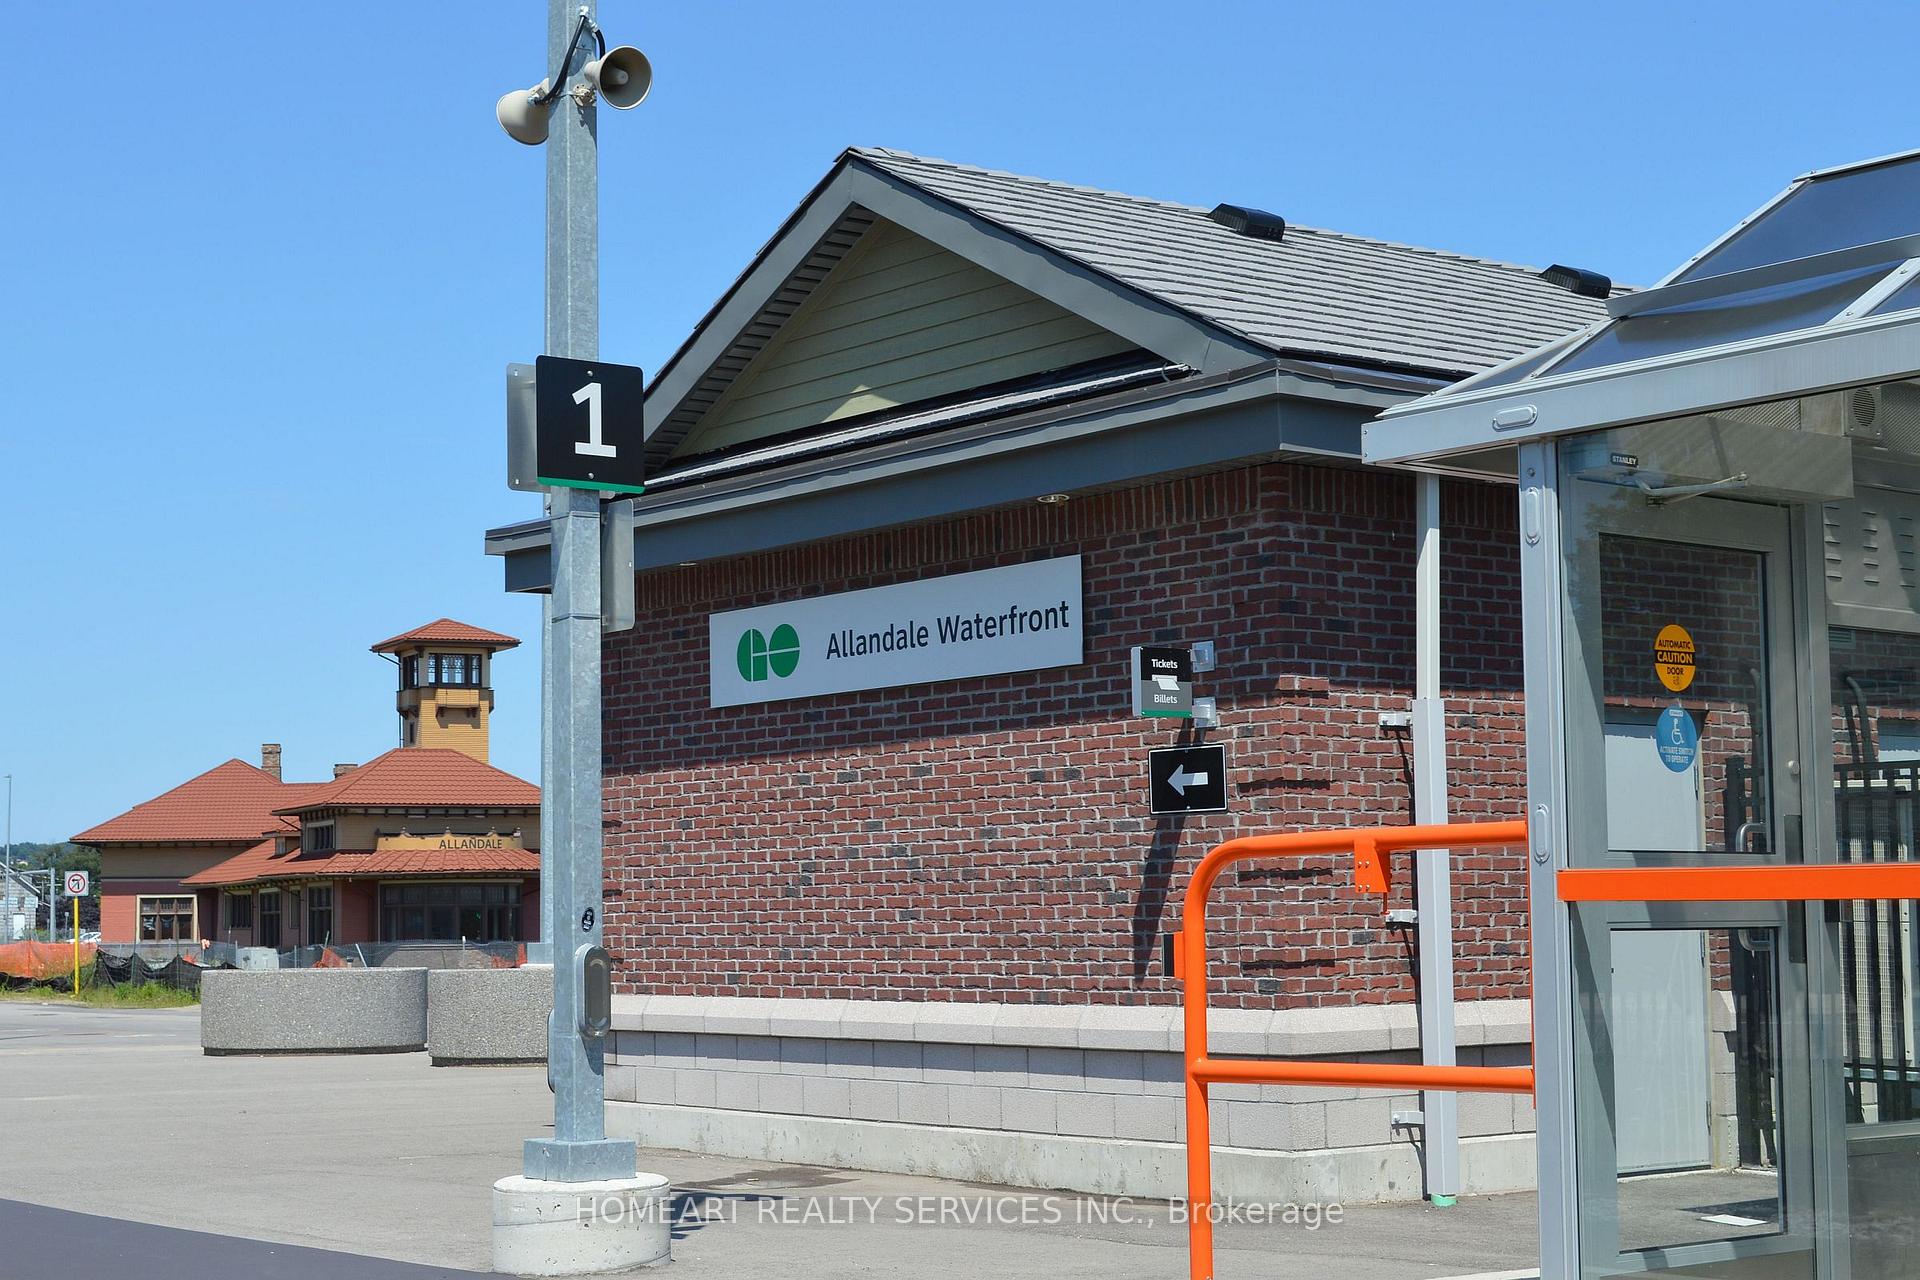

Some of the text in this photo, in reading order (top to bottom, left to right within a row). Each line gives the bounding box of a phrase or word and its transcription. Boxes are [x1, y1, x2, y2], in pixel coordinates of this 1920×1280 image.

[572, 382, 617, 458] 1
[1612, 455, 1637, 465] STANLEY
[826, 600, 1070, 660] Allandale Waterfront
[1658, 639, 1691, 649] AUTOMATIC
[1657, 651, 1693, 664] CAUTION
[1151, 658, 1178, 669] Tickets
[1666, 666, 1685, 676] DOOR
[1153, 694, 1178, 704] Billets
[439, 839, 503, 849] ALLANDALE
